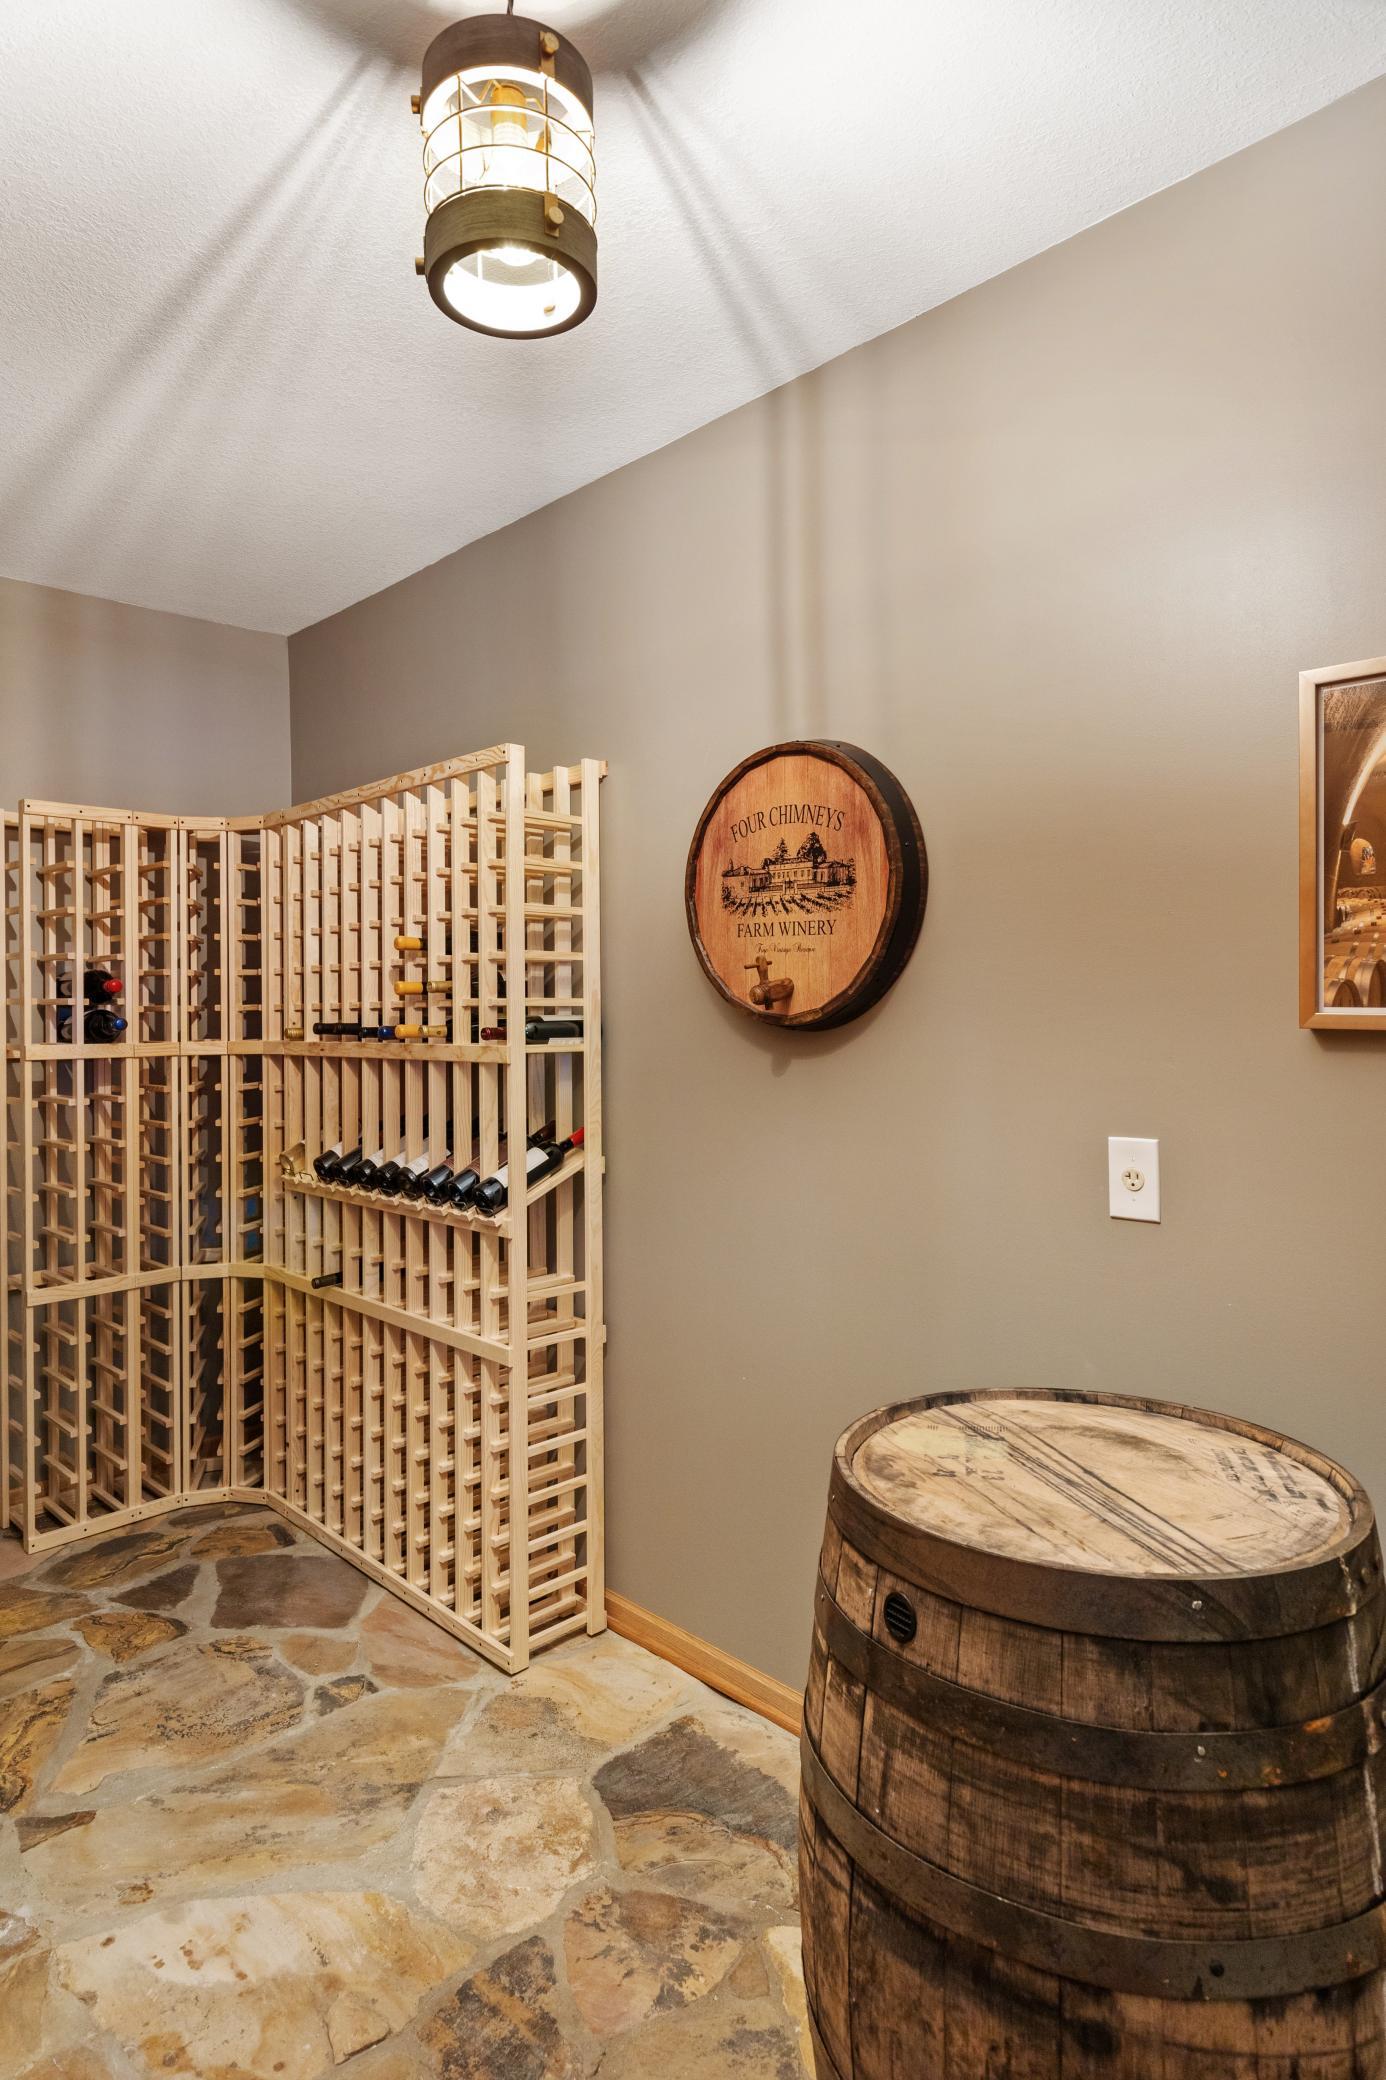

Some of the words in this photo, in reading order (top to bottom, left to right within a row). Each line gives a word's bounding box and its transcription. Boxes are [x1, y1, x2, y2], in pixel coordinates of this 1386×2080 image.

[730, 811, 767, 843] FOUR
[769, 804, 846, 832] CHIMNEYS
[737, 922, 775, 938] FARM
[778, 919, 837, 937] WINERY
